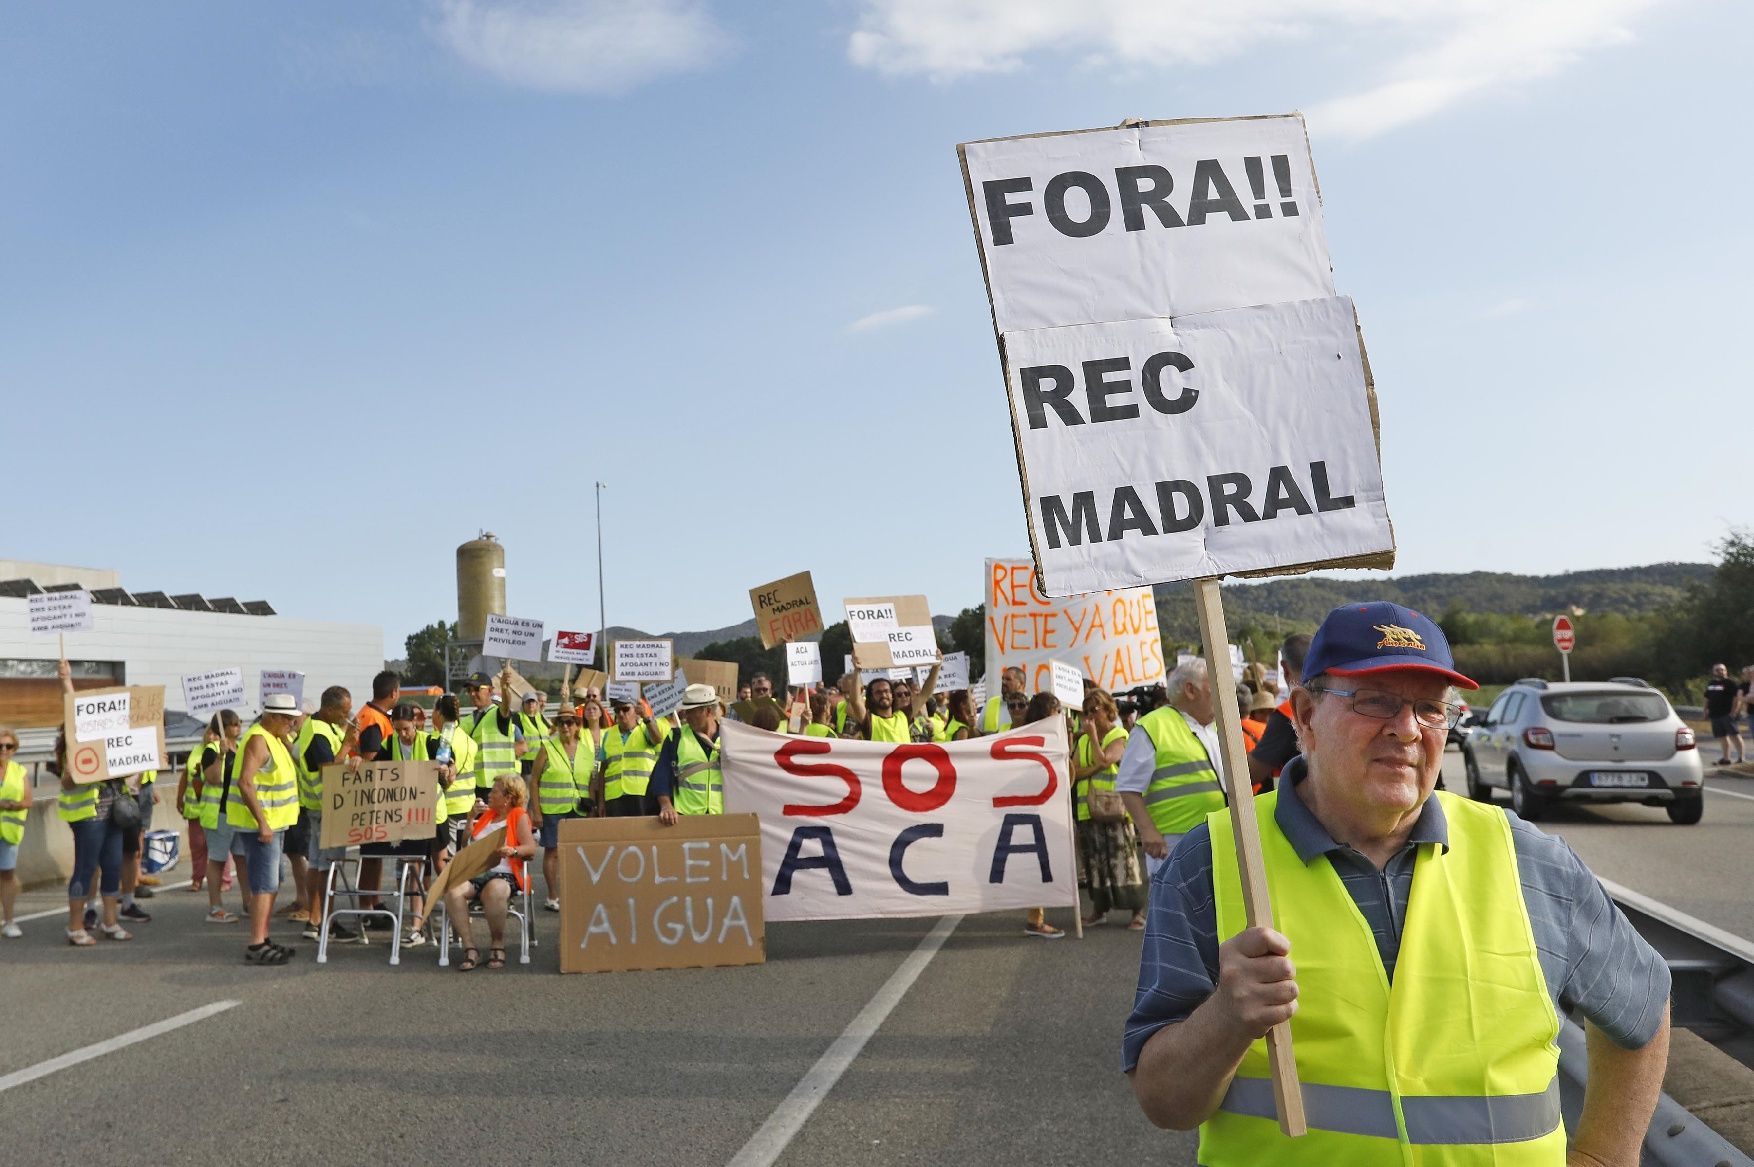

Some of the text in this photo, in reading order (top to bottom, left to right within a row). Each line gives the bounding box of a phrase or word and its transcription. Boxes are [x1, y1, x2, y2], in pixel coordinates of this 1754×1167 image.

[982, 154, 1299, 247] FORA!!
[1019, 352, 1200, 430] REC
[1039, 461, 1356, 549] MADRAL
[758, 589, 781, 609] REC
[992, 563, 1051, 608] REC
[772, 596, 811, 615] MADRAL
[849, 608, 893, 620] FORA!!
[768, 608, 819, 642] FORA
[888, 632, 913, 643] REC
[989, 594, 1158, 655] VETE YA QUE
[892, 648, 936, 660] MADRAL
[1084, 638, 1163, 690] VALES
[76, 699, 126, 716] FORA!!
[107, 735, 133, 748] REC
[109, 752, 155, 767] MADRAL
[774, 736, 1058, 817] SOS
[342, 767, 400, 787] FARTS
[347, 825, 388, 843] SOS
[576, 841, 750, 885] VOLEM
[771, 813, 1053, 896] ACA
[580, 895, 754, 949] AIGUA
